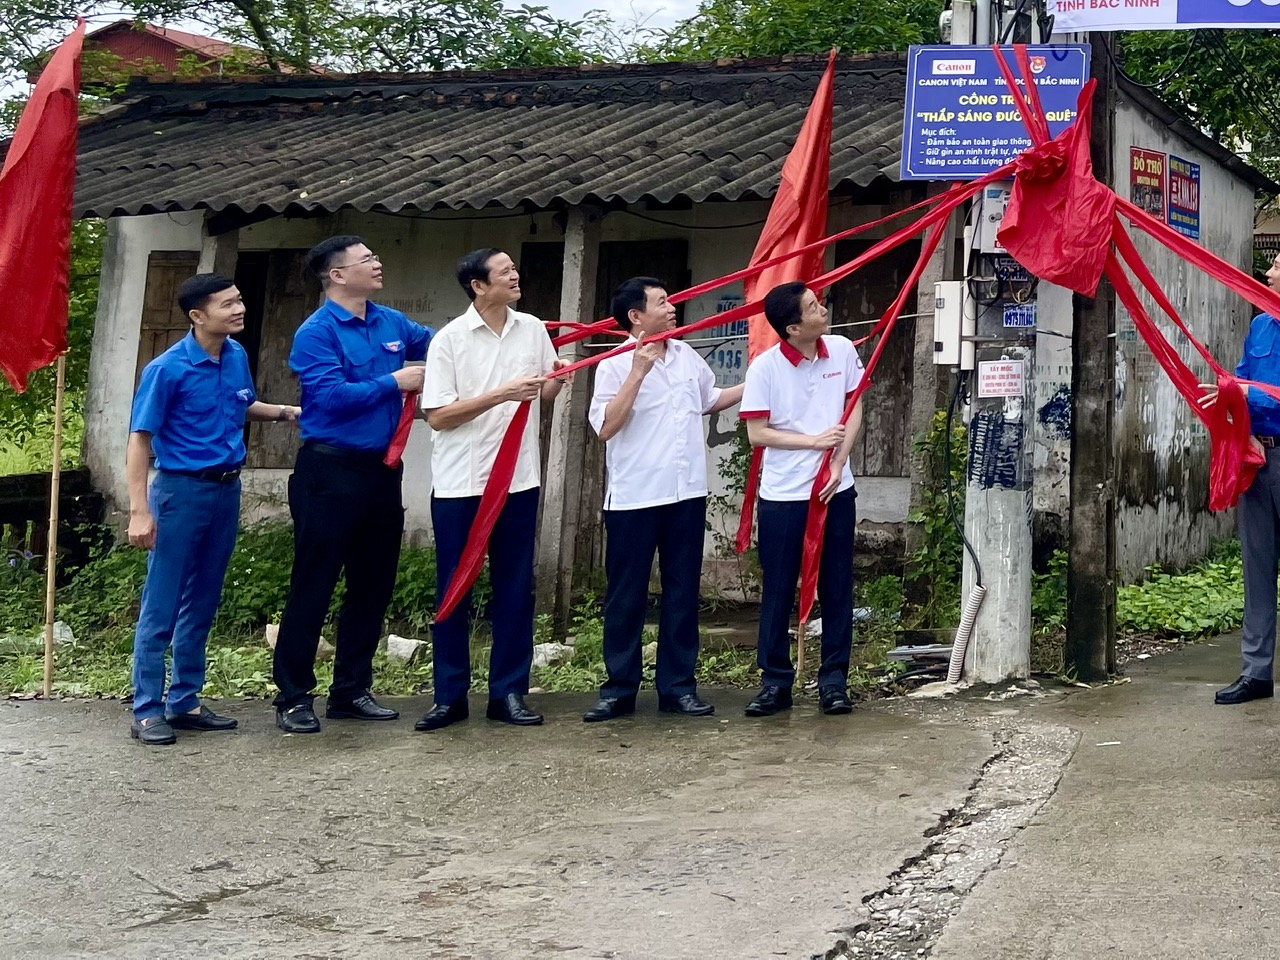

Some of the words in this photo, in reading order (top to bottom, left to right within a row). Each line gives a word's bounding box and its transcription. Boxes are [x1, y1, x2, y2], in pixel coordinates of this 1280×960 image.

[936, 63, 972, 71] Canon
[951, 77, 967, 87] VIỆT
[994, 76, 1011, 86] TỈN
[1040, 75, 1058, 86] BẮC
[1059, 78, 1080, 86] NINH
[959, 92, 998, 106] CÔNG
[957, 109, 993, 122] SÁNG
[921, 128, 937, 137] Mục
[973, 138, 991, 146] toàn
[992, 138, 1008, 147] giao
[1010, 137, 1032, 147] thông
[984, 147, 998, 157] trật
[925, 157, 946, 166] Nâng
[962, 156, 979, 165] chất
[981, 157, 1003, 166] lượng
